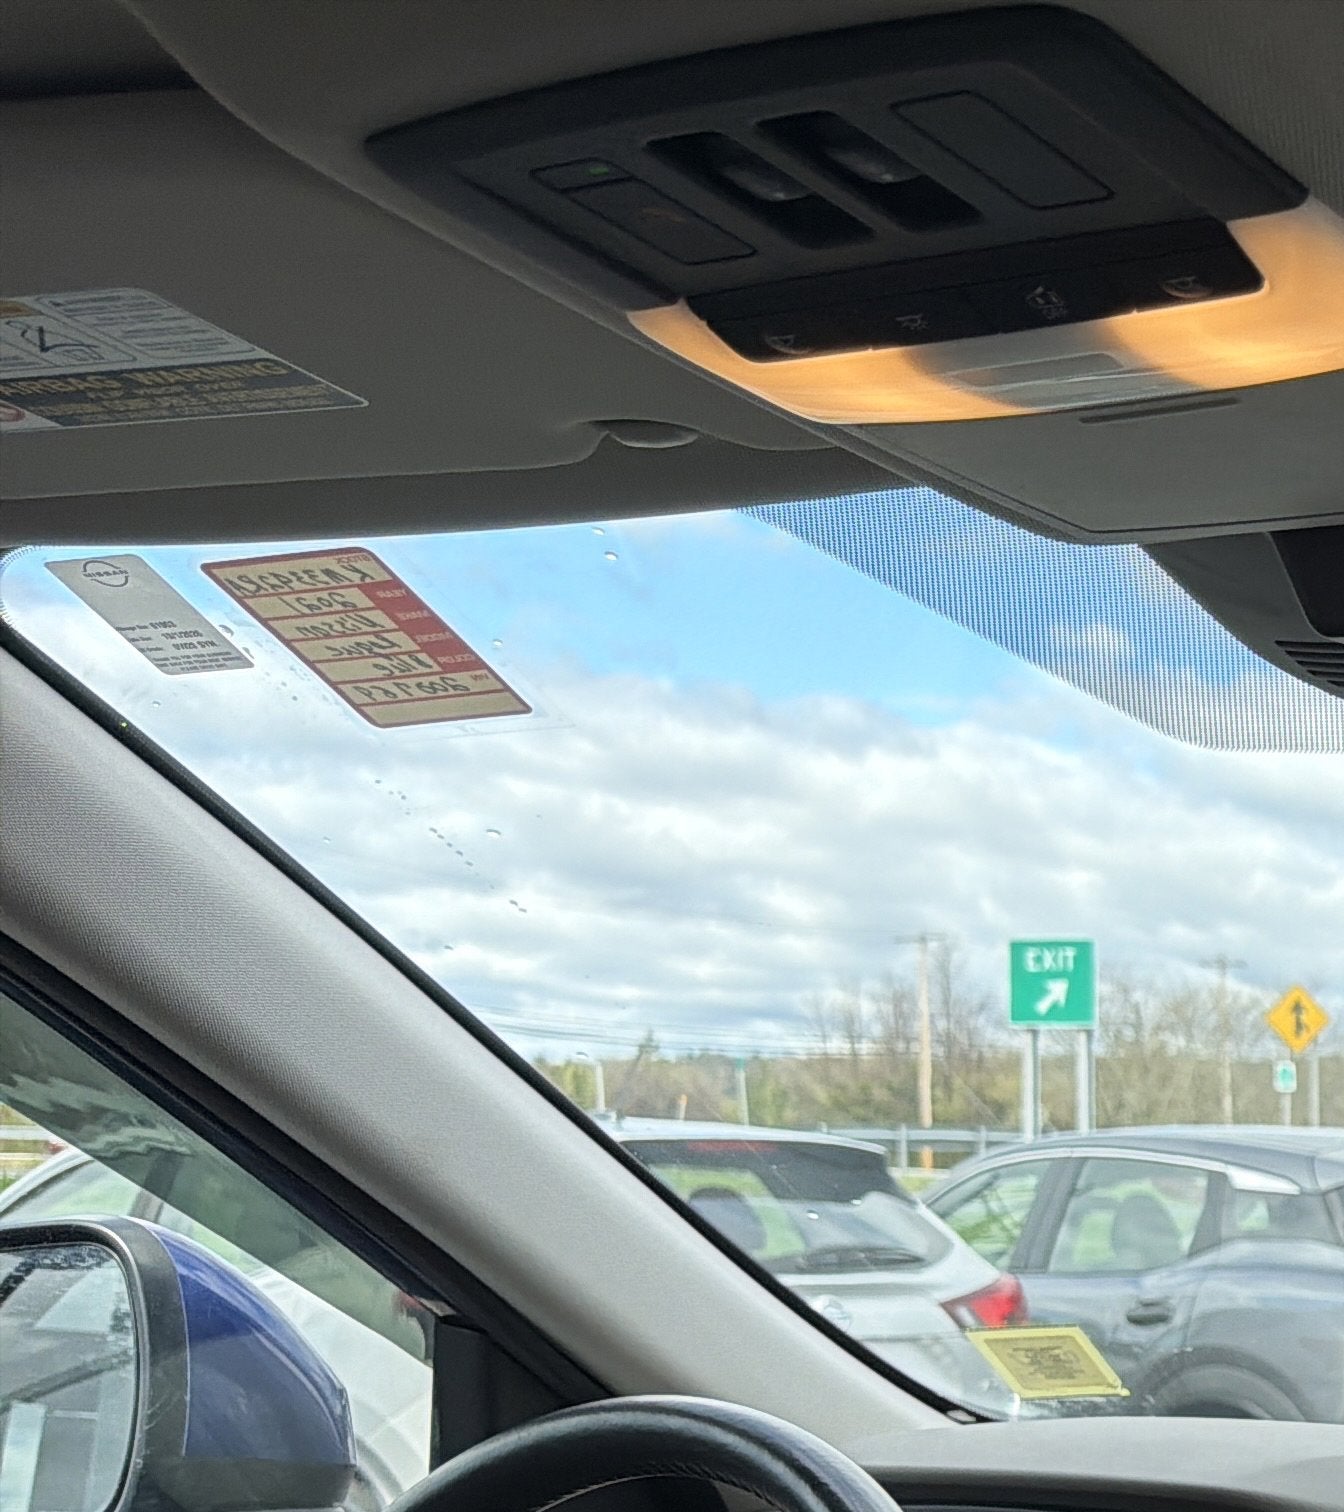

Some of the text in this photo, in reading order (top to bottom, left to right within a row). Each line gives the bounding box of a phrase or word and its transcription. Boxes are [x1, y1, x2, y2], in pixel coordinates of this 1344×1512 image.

[123, 361, 290, 387] WARNING
[83, 569, 129, 578] NISSAN
[1024, 946, 1077, 973] EXIT
